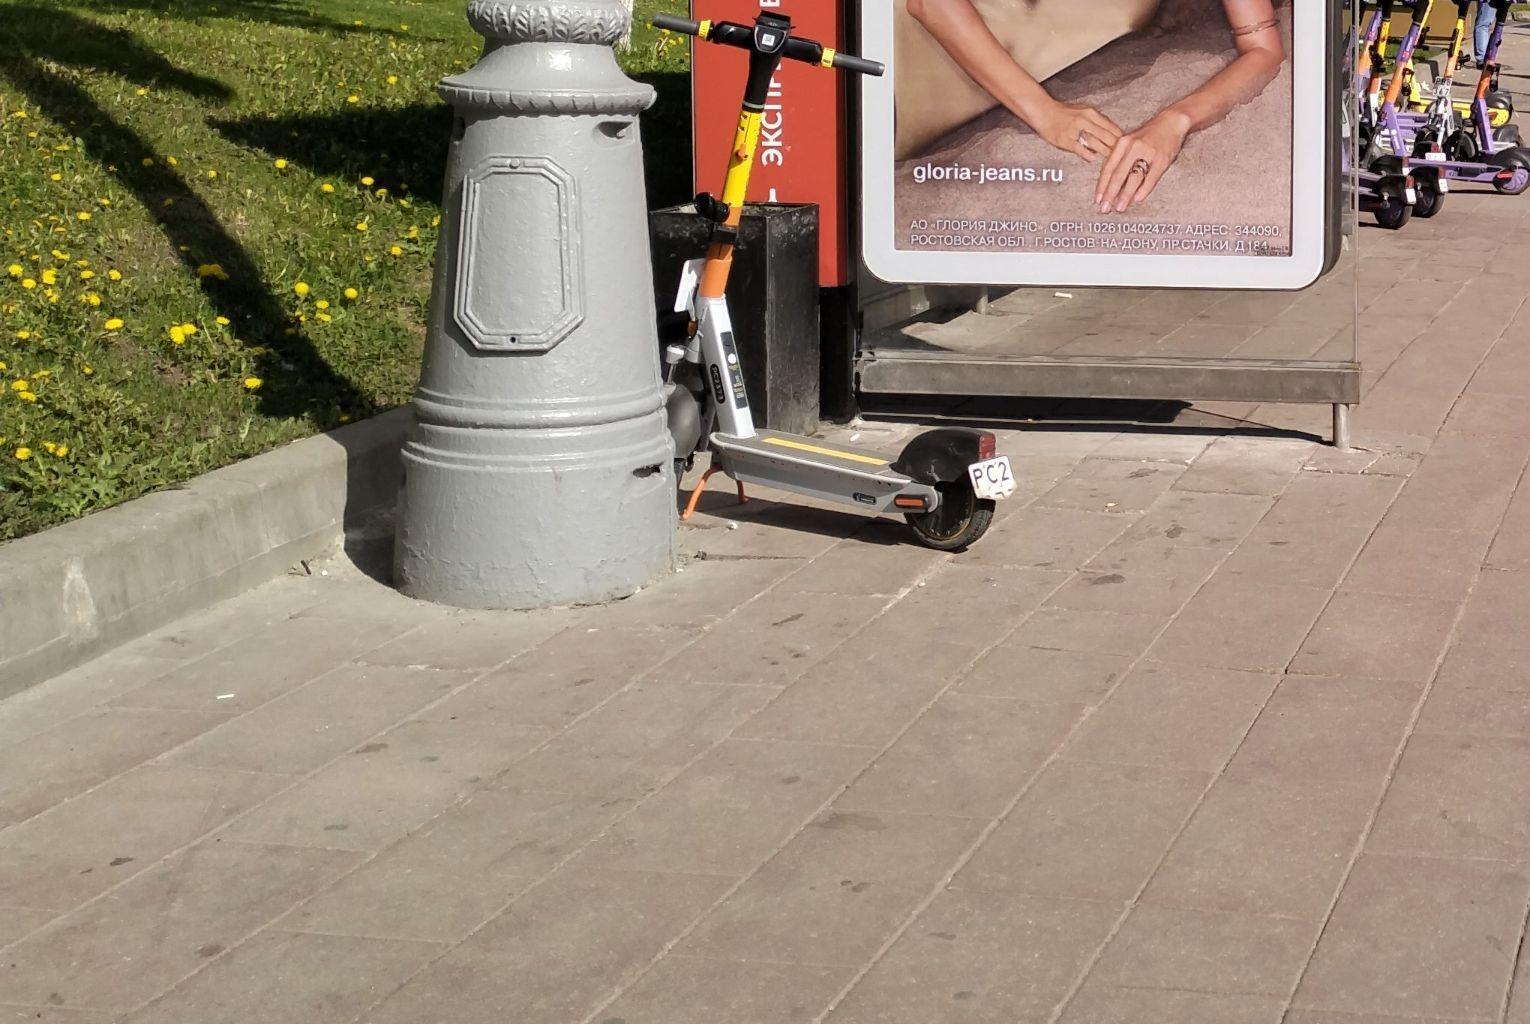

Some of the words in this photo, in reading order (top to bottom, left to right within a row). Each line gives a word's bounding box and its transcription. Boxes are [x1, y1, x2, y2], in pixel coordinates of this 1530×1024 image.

[760, 56, 783, 167] ЭКСП
[912, 162, 1064, 185] gloria-jeans.ru
[910, 219, 928, 231] АО
[930, 220, 986, 231] «ГЛОРИЯ
[1049, 222, 1084, 233] ОГРН
[1185, 224, 1232, 237] АДРЕС:
[1234, 225, 1283, 237] 344090,
[910, 235, 995, 246] РОСТОВСКАЯ
